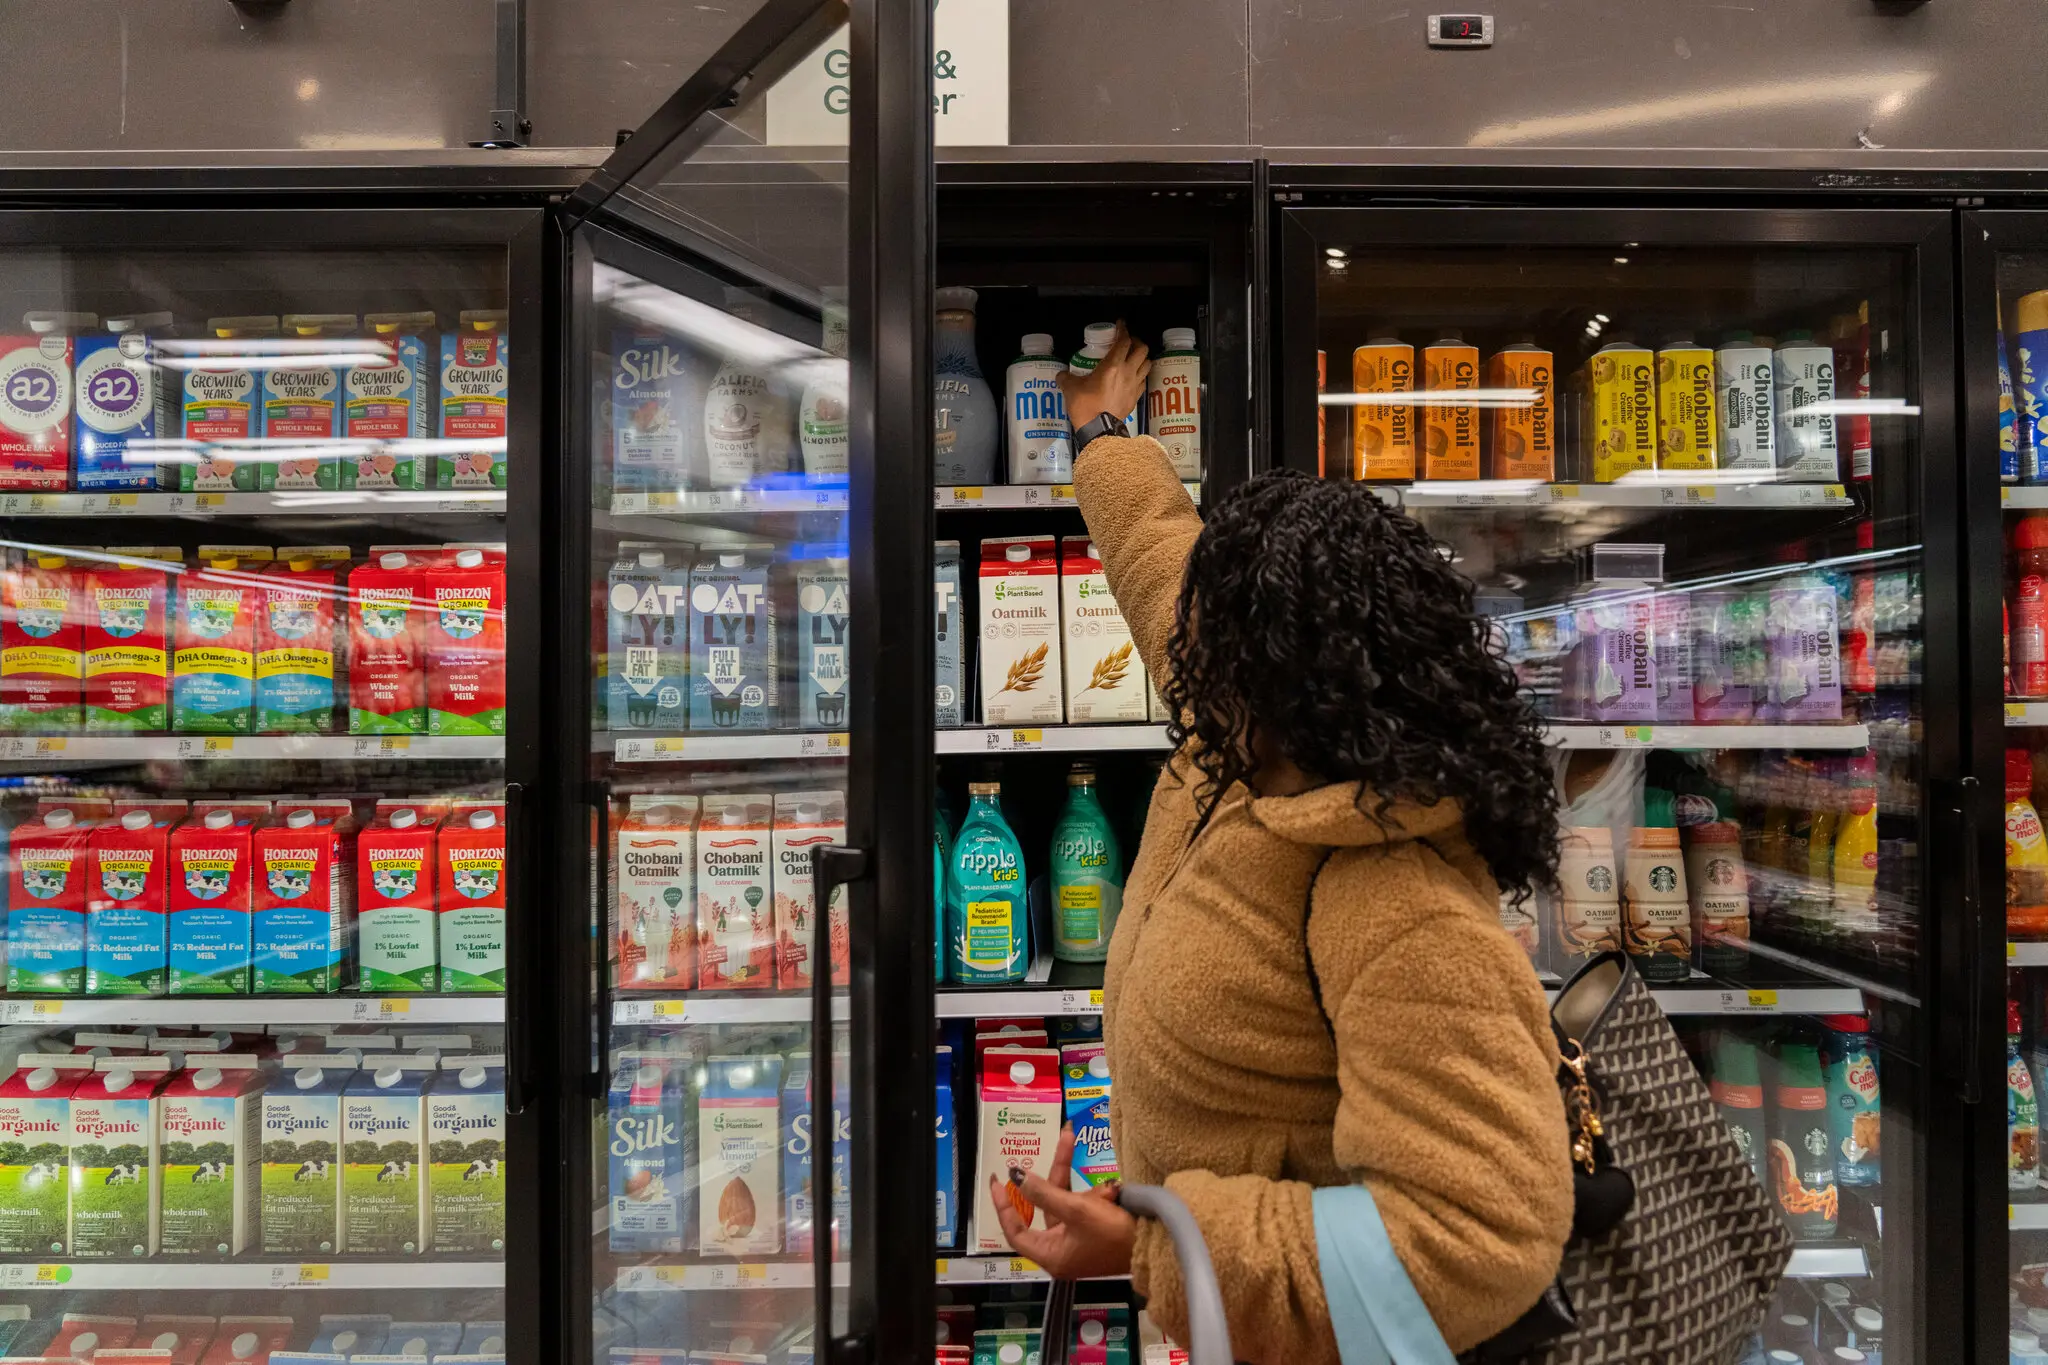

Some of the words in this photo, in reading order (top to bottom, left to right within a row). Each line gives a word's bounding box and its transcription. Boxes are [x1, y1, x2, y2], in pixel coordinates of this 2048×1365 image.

[615, 346, 685, 389] Silk
[1162, 374, 1188, 386] oat
[12, 376, 52, 403] a2
[94, 376, 133, 403] a2
[630, 390, 672, 399] Almond
[1626, 396, 1634, 422] Coffee
[1634, 363, 1654, 451] Chobani
[1692, 364, 1713, 452] Chobani
[1754, 364, 1774, 452] Chobani
[1161, 426, 1194, 434] ORIGINAL
[1, 443, 33, 452] WHOLE
[34, 444, 56, 453] MILK
[708, 574, 741, 582] ORIGINAL
[187, 588, 244, 600] HORIZON
[359, 588, 414, 600] HORIZON
[435, 587, 491, 600] HORIZON
[992, 606, 1047, 620] Oatmilk
[1076, 606, 1121, 618] Oatmi
[88, 654, 112, 664] DHA
[114, 652, 161, 664] Omega-3
[178, 654, 200, 664] DHA
[202, 652, 248, 665] Omega-3
[630, 650, 654, 664] FULL
[713, 650, 736, 664] FULL
[632, 664, 651, 676] FAT
[715, 664, 732, 676] FAT
[816, 666, 842, 679] MILK
[714, 677, 737, 685] OATMILK
[112, 686, 136, 694] Whole
[370, 683, 398, 691] Whole
[450, 684, 479, 692] Whole
[115, 694, 132, 702] Milk
[374, 692, 394, 700] Milk
[454, 692, 475, 700] Milk
[987, 734, 1000, 743] 2.70
[2006, 817, 2038, 834] Coffee
[2016, 828, 2040, 840] mate
[1055, 836, 1106, 860] ripple
[98, 849, 154, 862] HORIZON
[181, 848, 238, 861] HORIZON
[264, 848, 318, 861] HORIZON
[369, 848, 424, 860] HORIZON
[450, 848, 505, 860] HORIZON
[625, 851, 683, 865] Chobani
[704, 851, 763, 864] Chobani
[106, 862, 145, 870] ORGANIC
[188, 862, 229, 870] ORGANIC
[271, 862, 310, 870] ORGANIC
[376, 861, 416, 870] ORGANIC
[458, 861, 497, 869] ORGANIC
[960, 848, 1016, 874] ripple
[628, 865, 680, 878] Oatmilk
[708, 865, 760, 878] Oatmilk
[651, 880, 672, 889] Creamy
[732, 880, 753, 888] Creamy
[976, 907, 1004, 915] Pediatrician
[1704, 902, 1740, 910] OATMILK
[972, 912, 1008, 920] Recommended
[1586, 909, 1616, 917] OATMILK
[1648, 909, 1682, 917] OATMILK
[187, 943, 227, 952] Reduced
[256, 943, 268, 951] 2%
[270, 943, 309, 951] Reduced
[310, 943, 325, 951] Fat
[374, 942, 386, 950] 1%
[388, 942, 420, 950] Lowfat
[470, 943, 502, 951] Lowfat
[196, 952, 217, 960] Milk
[280, 952, 299, 960] Milk
[386, 952, 407, 960] Milk
[468, 952, 488, 960] Milk
[1068, 1090, 1082, 1098] 50%
[76, 1120, 140, 1138] organic
[164, 1118, 226, 1137] organic
[267, 1116, 329, 1134] organic
[349, 1116, 410, 1134] organic
[433, 1116, 497, 1134] organic
[726, 1122, 742, 1130] Plant
[611, 1114, 680, 1157] Silk
[720, 1142, 754, 1151] Vanilla
[1000, 1136, 1041, 1149] Original
[1000, 1148, 1040, 1156] Almond
[624, 1158, 665, 1167] Almond
[278, 1194, 313, 1204] reduced
[265, 1204, 276, 1214] fat
[277, 1204, 297, 1213] milk
[76, 1210, 101, 1220] whole
[102, 1210, 122, 1219] milk
